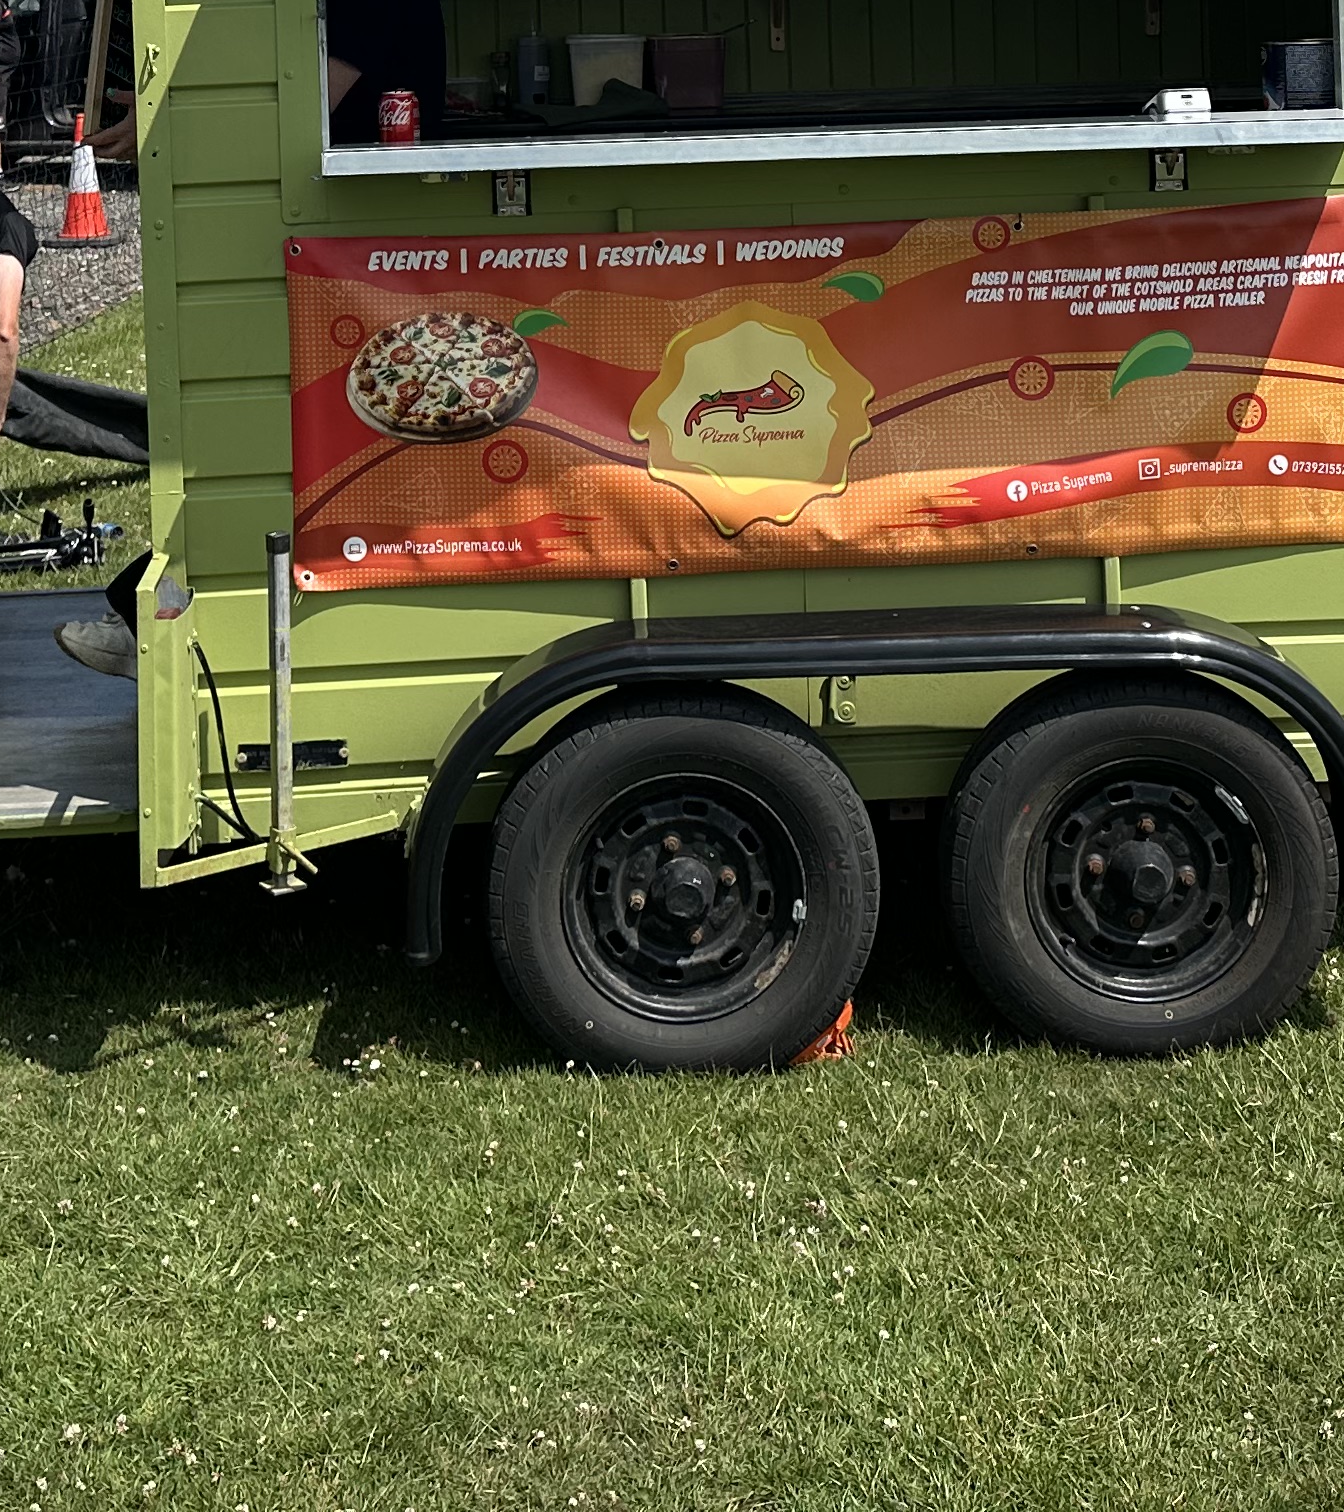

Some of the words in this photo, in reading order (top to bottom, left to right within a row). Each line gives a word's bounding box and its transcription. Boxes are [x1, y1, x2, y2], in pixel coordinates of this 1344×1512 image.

[378, 98, 413, 126] Cola
[367, 249, 450, 272] EVENTS
[478, 247, 569, 270] PARTIES
[596, 243, 707, 267] FESTIVALS
[735, 237, 845, 262] WEDDINGS
[971, 271, 1009, 286] BASED
[1011, 270, 1023, 284] IN
[1027, 267, 1102, 284] CHELTENHAM
[1105, 266, 1122, 282] WE
[1125, 264, 1159, 280] BRING
[1162, 260, 1218, 278] DELICIOUS
[1219, 256, 1281, 275] ARTISANAL
[965, 288, 1004, 304] PIZZAS
[1008, 287, 1023, 302] TO
[1027, 286, 1048, 301] THE
[1051, 284, 1089, 300] HEART
[1092, 283, 1108, 299] OF
[1110, 282, 1131, 297] THE
[1134, 279, 1194, 296] COTSWOLD
[1197, 276, 1234, 292] AREAS
[1236, 273, 1289, 289] CRAFTED
[1292, 270, 1327, 286] FRESH
[1070, 300, 1094, 316] OUR
[1097, 299, 1136, 315] UNIQUE
[1139, 296, 1180, 312] MOBILE
[1183, 294, 1215, 310] PIZZA
[1218, 291, 1265, 307] TRAILER
[698, 426, 740, 444] Pizza
[742, 425, 806, 448] Suprema
[1030, 479, 1061, 495] Pizza
[1062, 469, 1113, 491] Suprema
[372, 538, 523, 556] www.PizzaSuprema.co.uk
[1134, 708, 1251, 762] NANKANG
